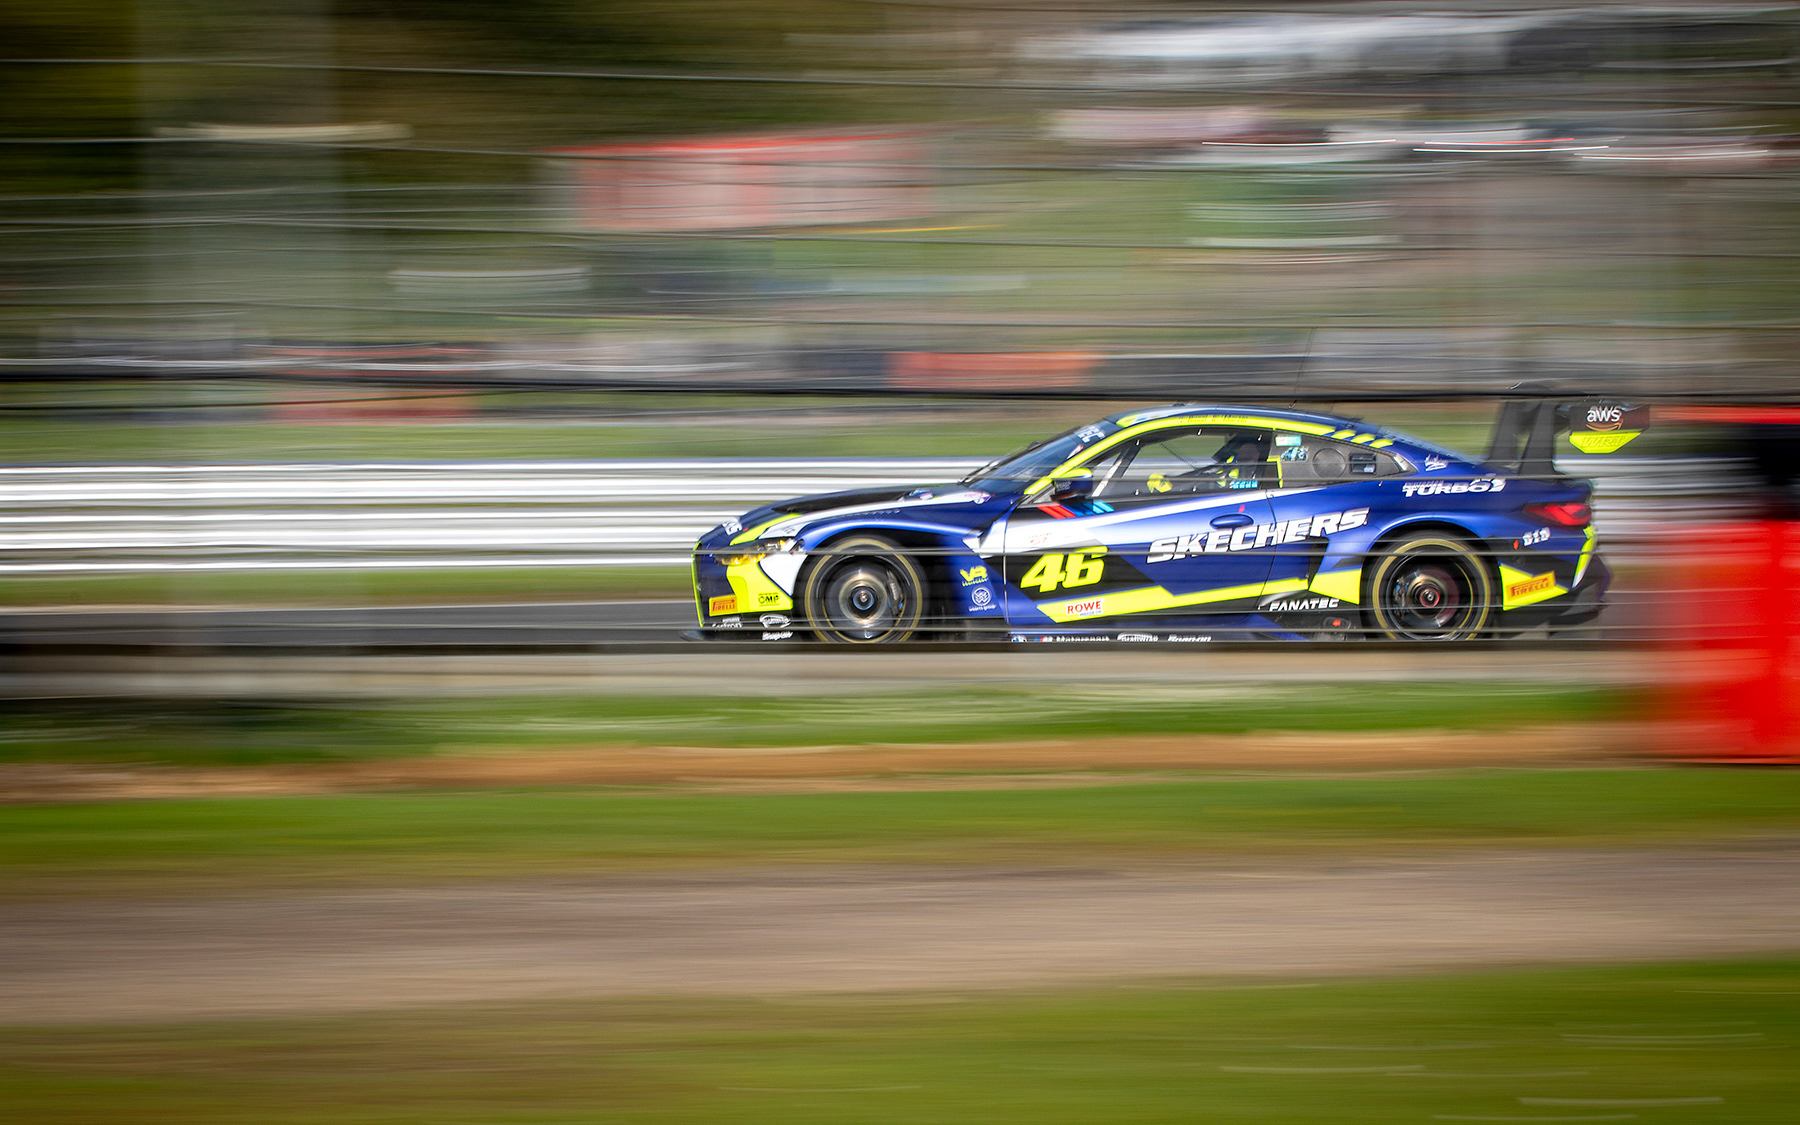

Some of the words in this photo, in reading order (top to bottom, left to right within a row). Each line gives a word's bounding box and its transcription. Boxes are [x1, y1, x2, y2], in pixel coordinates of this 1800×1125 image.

[1586, 404, 1622, 422] aws
[1146, 507, 1370, 564] SKECHERS
[1020, 545, 1108, 592] 46
[1511, 577, 1549, 597] PIRELLI
[712, 599, 736, 612] PIRELLI
[758, 596, 779, 604] OMP
[1067, 600, 1102, 615] ROWE
[1269, 599, 1340, 612] FANATEC
